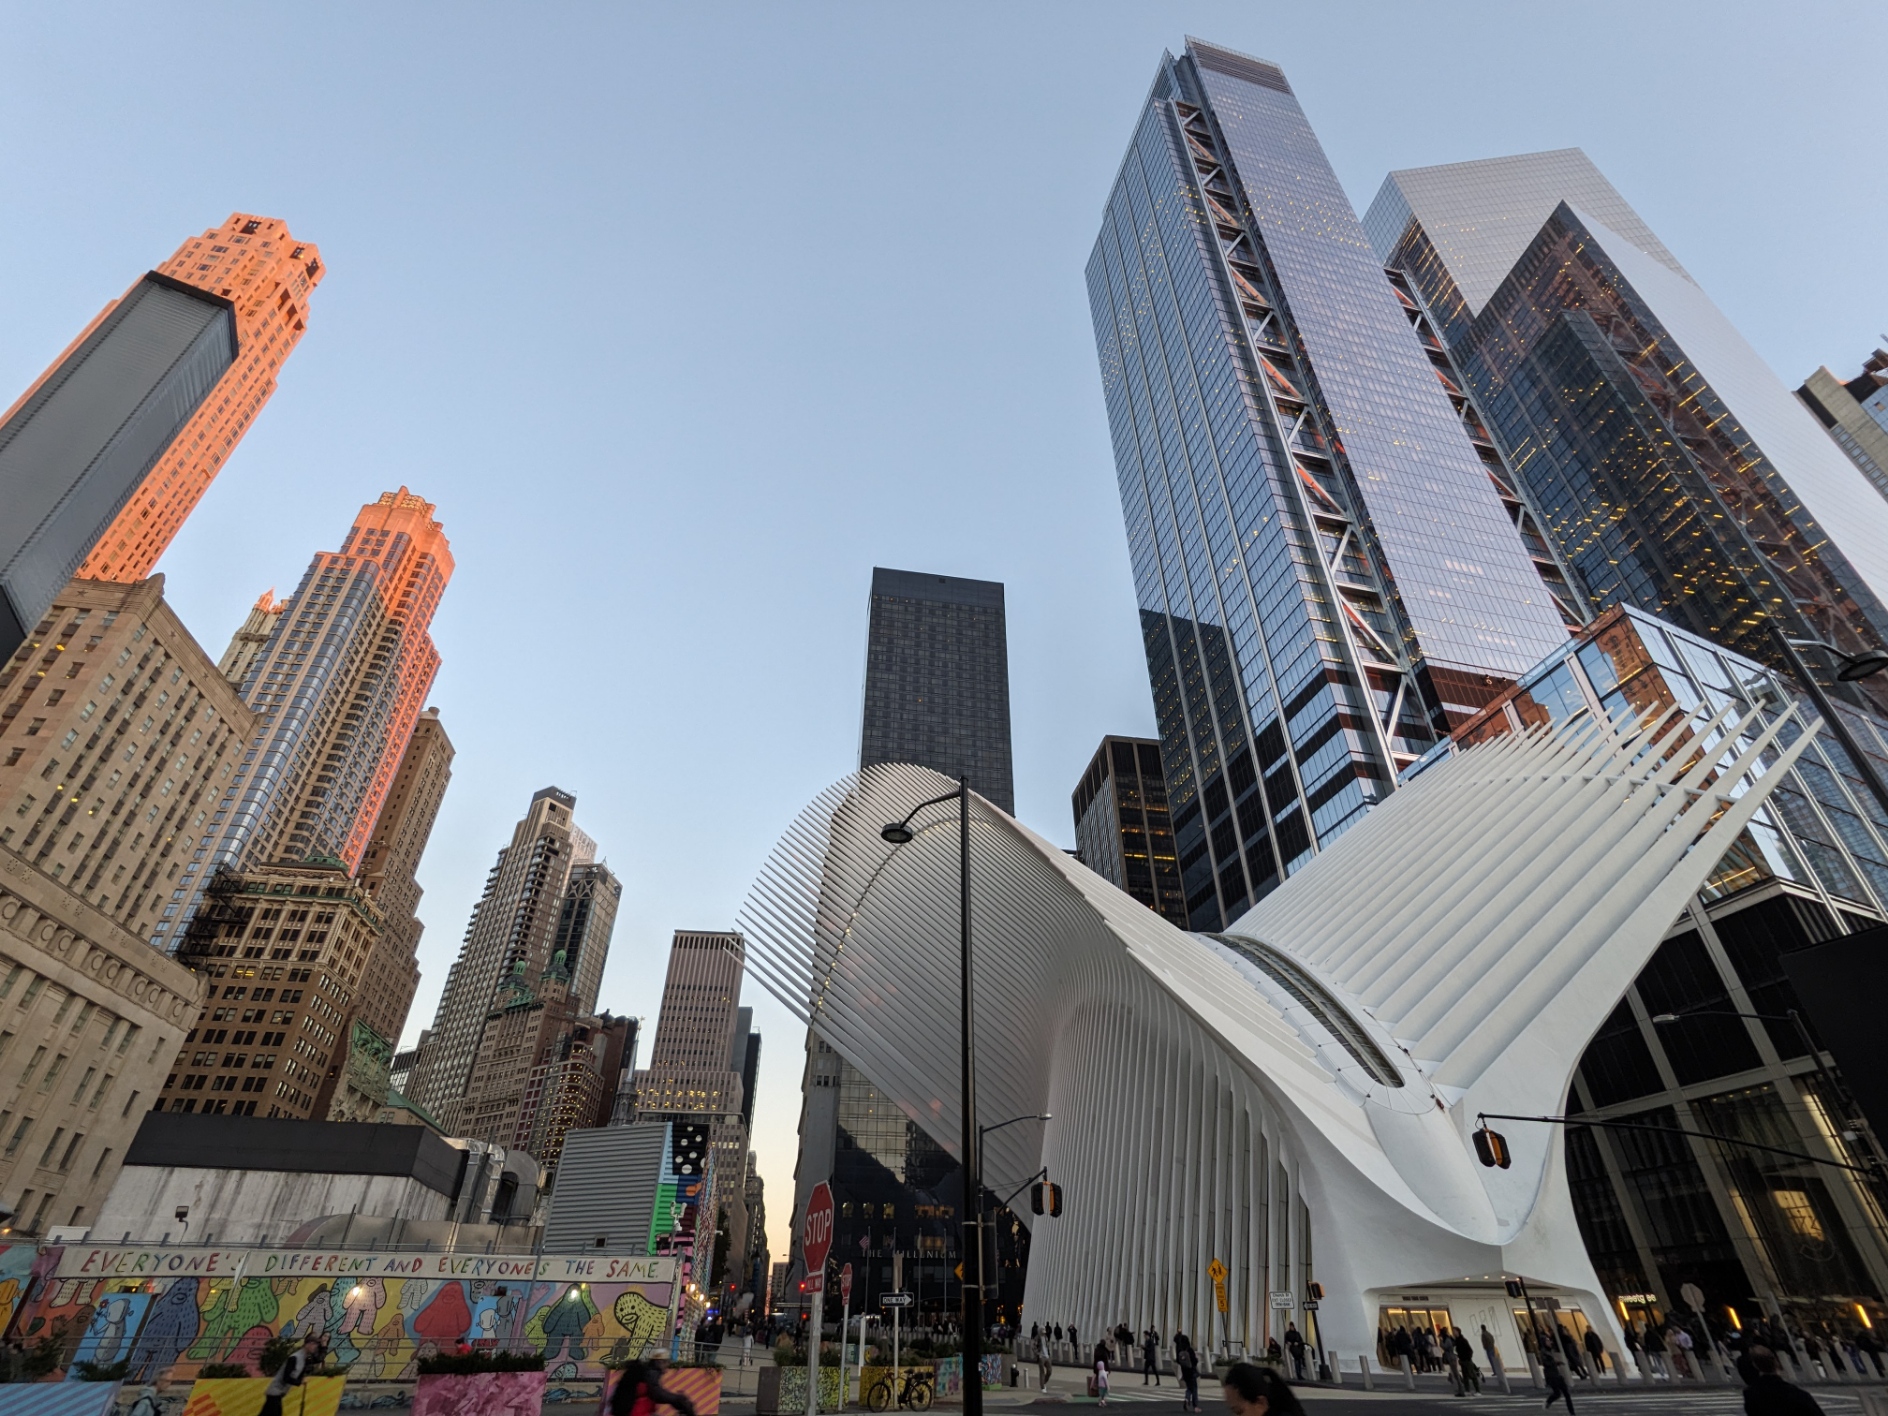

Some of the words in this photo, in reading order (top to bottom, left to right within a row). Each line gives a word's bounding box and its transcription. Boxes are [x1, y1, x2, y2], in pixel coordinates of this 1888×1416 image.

[805, 1208, 831, 1246] STOP
[265, 1253, 378, 1273] DIFFERENT
[383, 1257, 424, 1273] AND
[565, 1259, 595, 1275] THE
[606, 1259, 660, 1279] SAME.
[862, 1249, 882, 1258] THE
